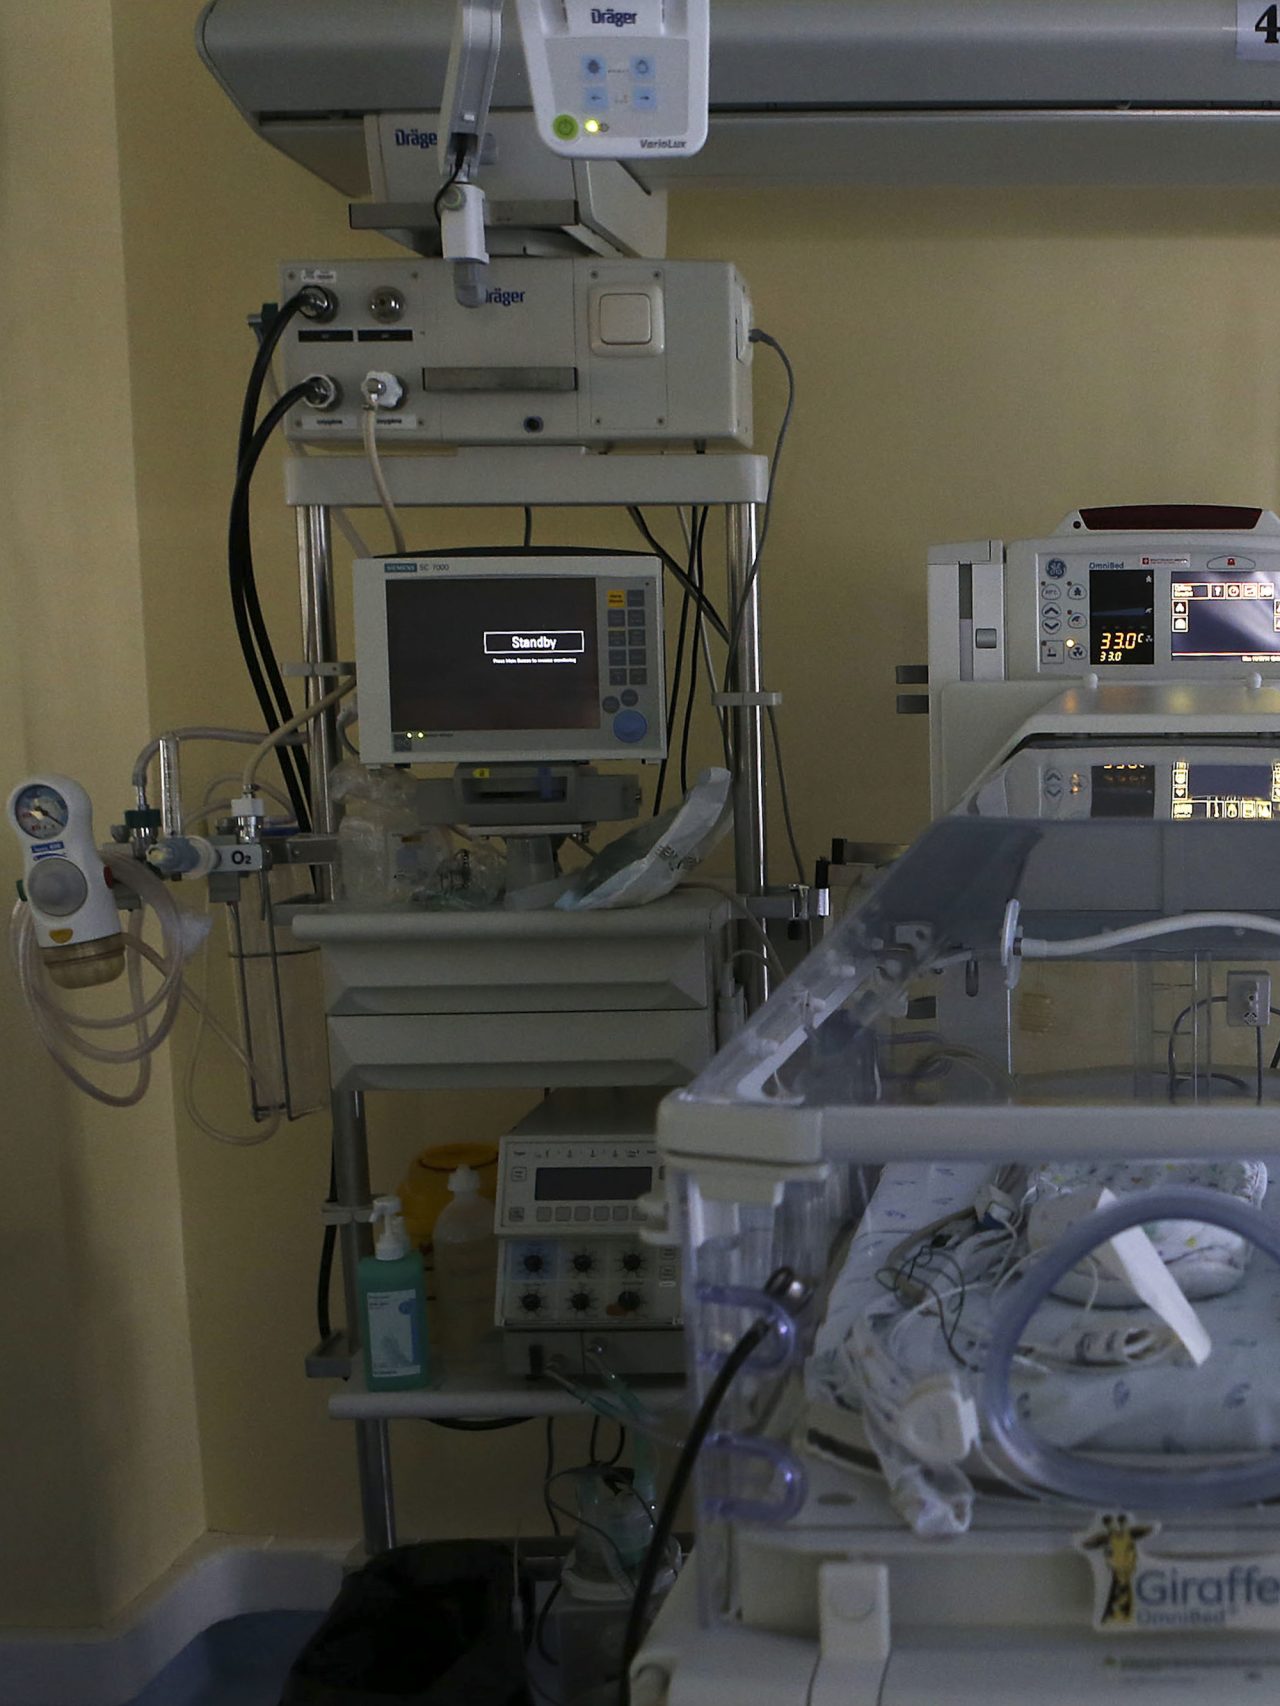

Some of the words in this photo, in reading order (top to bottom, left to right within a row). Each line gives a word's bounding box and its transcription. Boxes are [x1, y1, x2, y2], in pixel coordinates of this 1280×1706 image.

[591, 9, 637, 27] Dräger
[1255, 4, 1280, 44] 4
[395, 129, 438, 149] Dräge
[640, 139, 687, 149] VarioLux
[1089, 561, 1124, 569] OmniBed
[511, 635, 557, 650] Standby
[1100, 651, 1122, 662] 33.0
[1136, 1565, 1280, 1606] Giraffe
